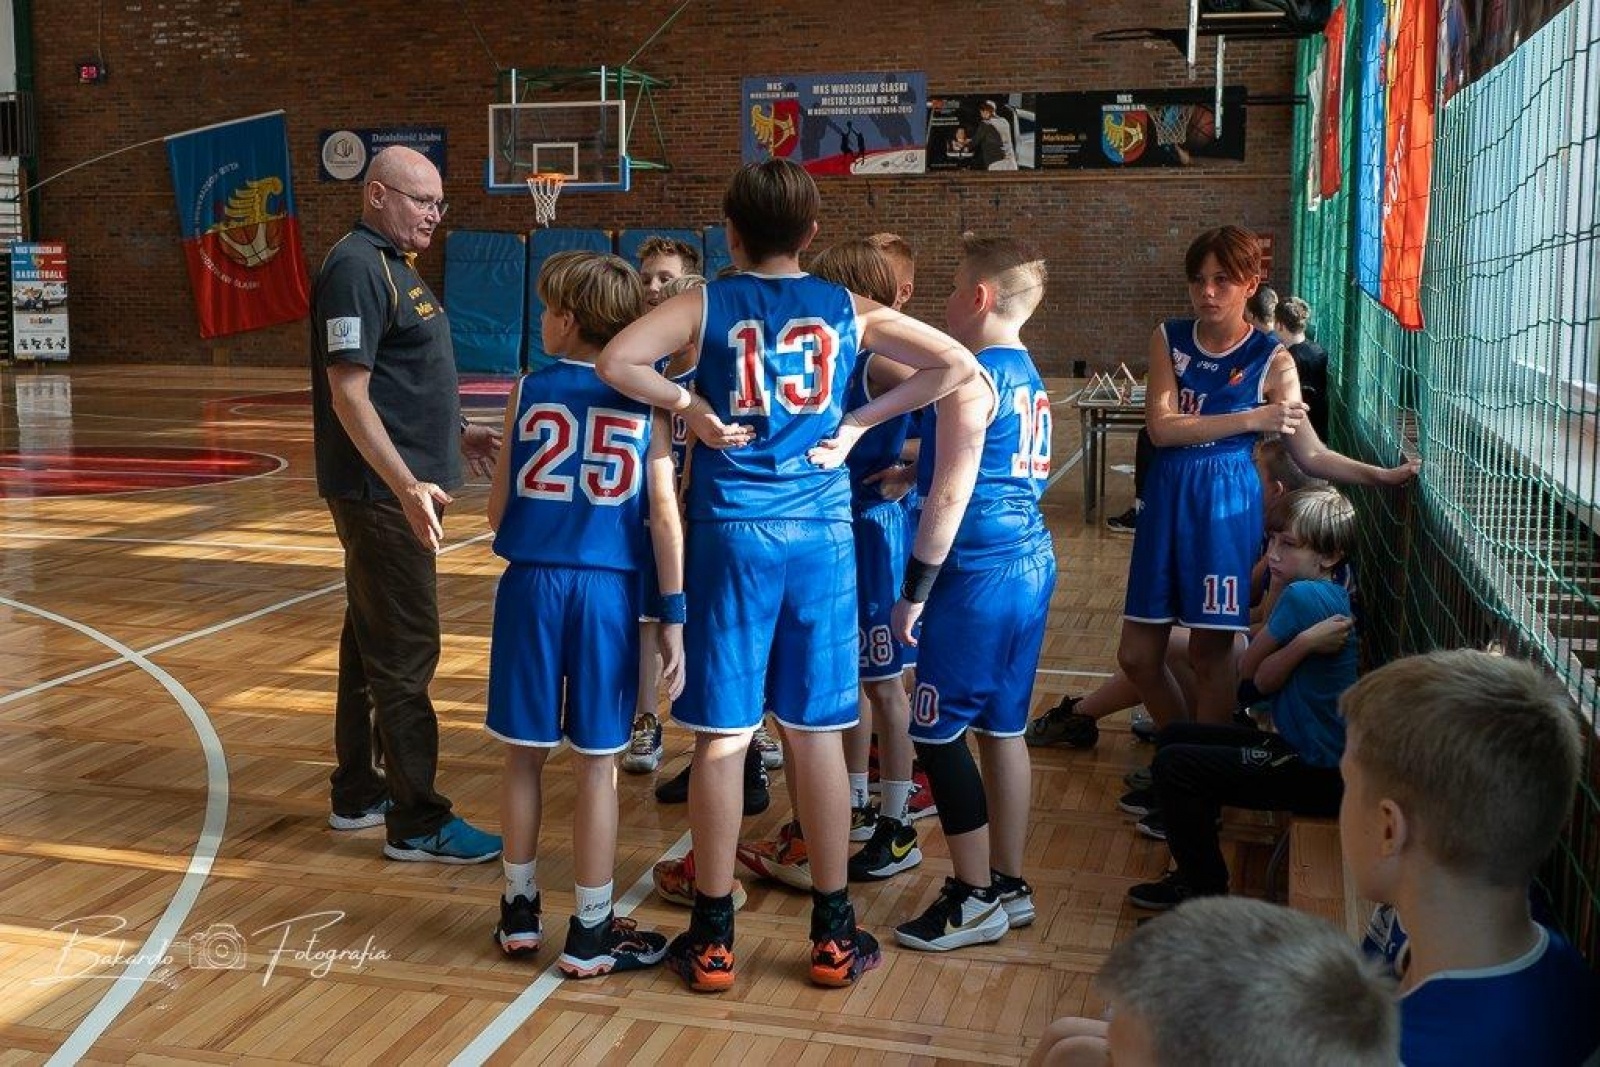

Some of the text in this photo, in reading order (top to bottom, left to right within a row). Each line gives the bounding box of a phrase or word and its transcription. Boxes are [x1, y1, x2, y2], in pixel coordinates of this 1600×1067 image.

[766, 82, 782, 91] MKS
[812, 85, 829, 95] MKS
[15, 269, 64, 279] BASKETBALL
[727, 316, 838, 416] 13
[1011, 387, 1052, 478] 10
[517, 403, 649, 506] 25
[1203, 575, 1240, 615] 11
